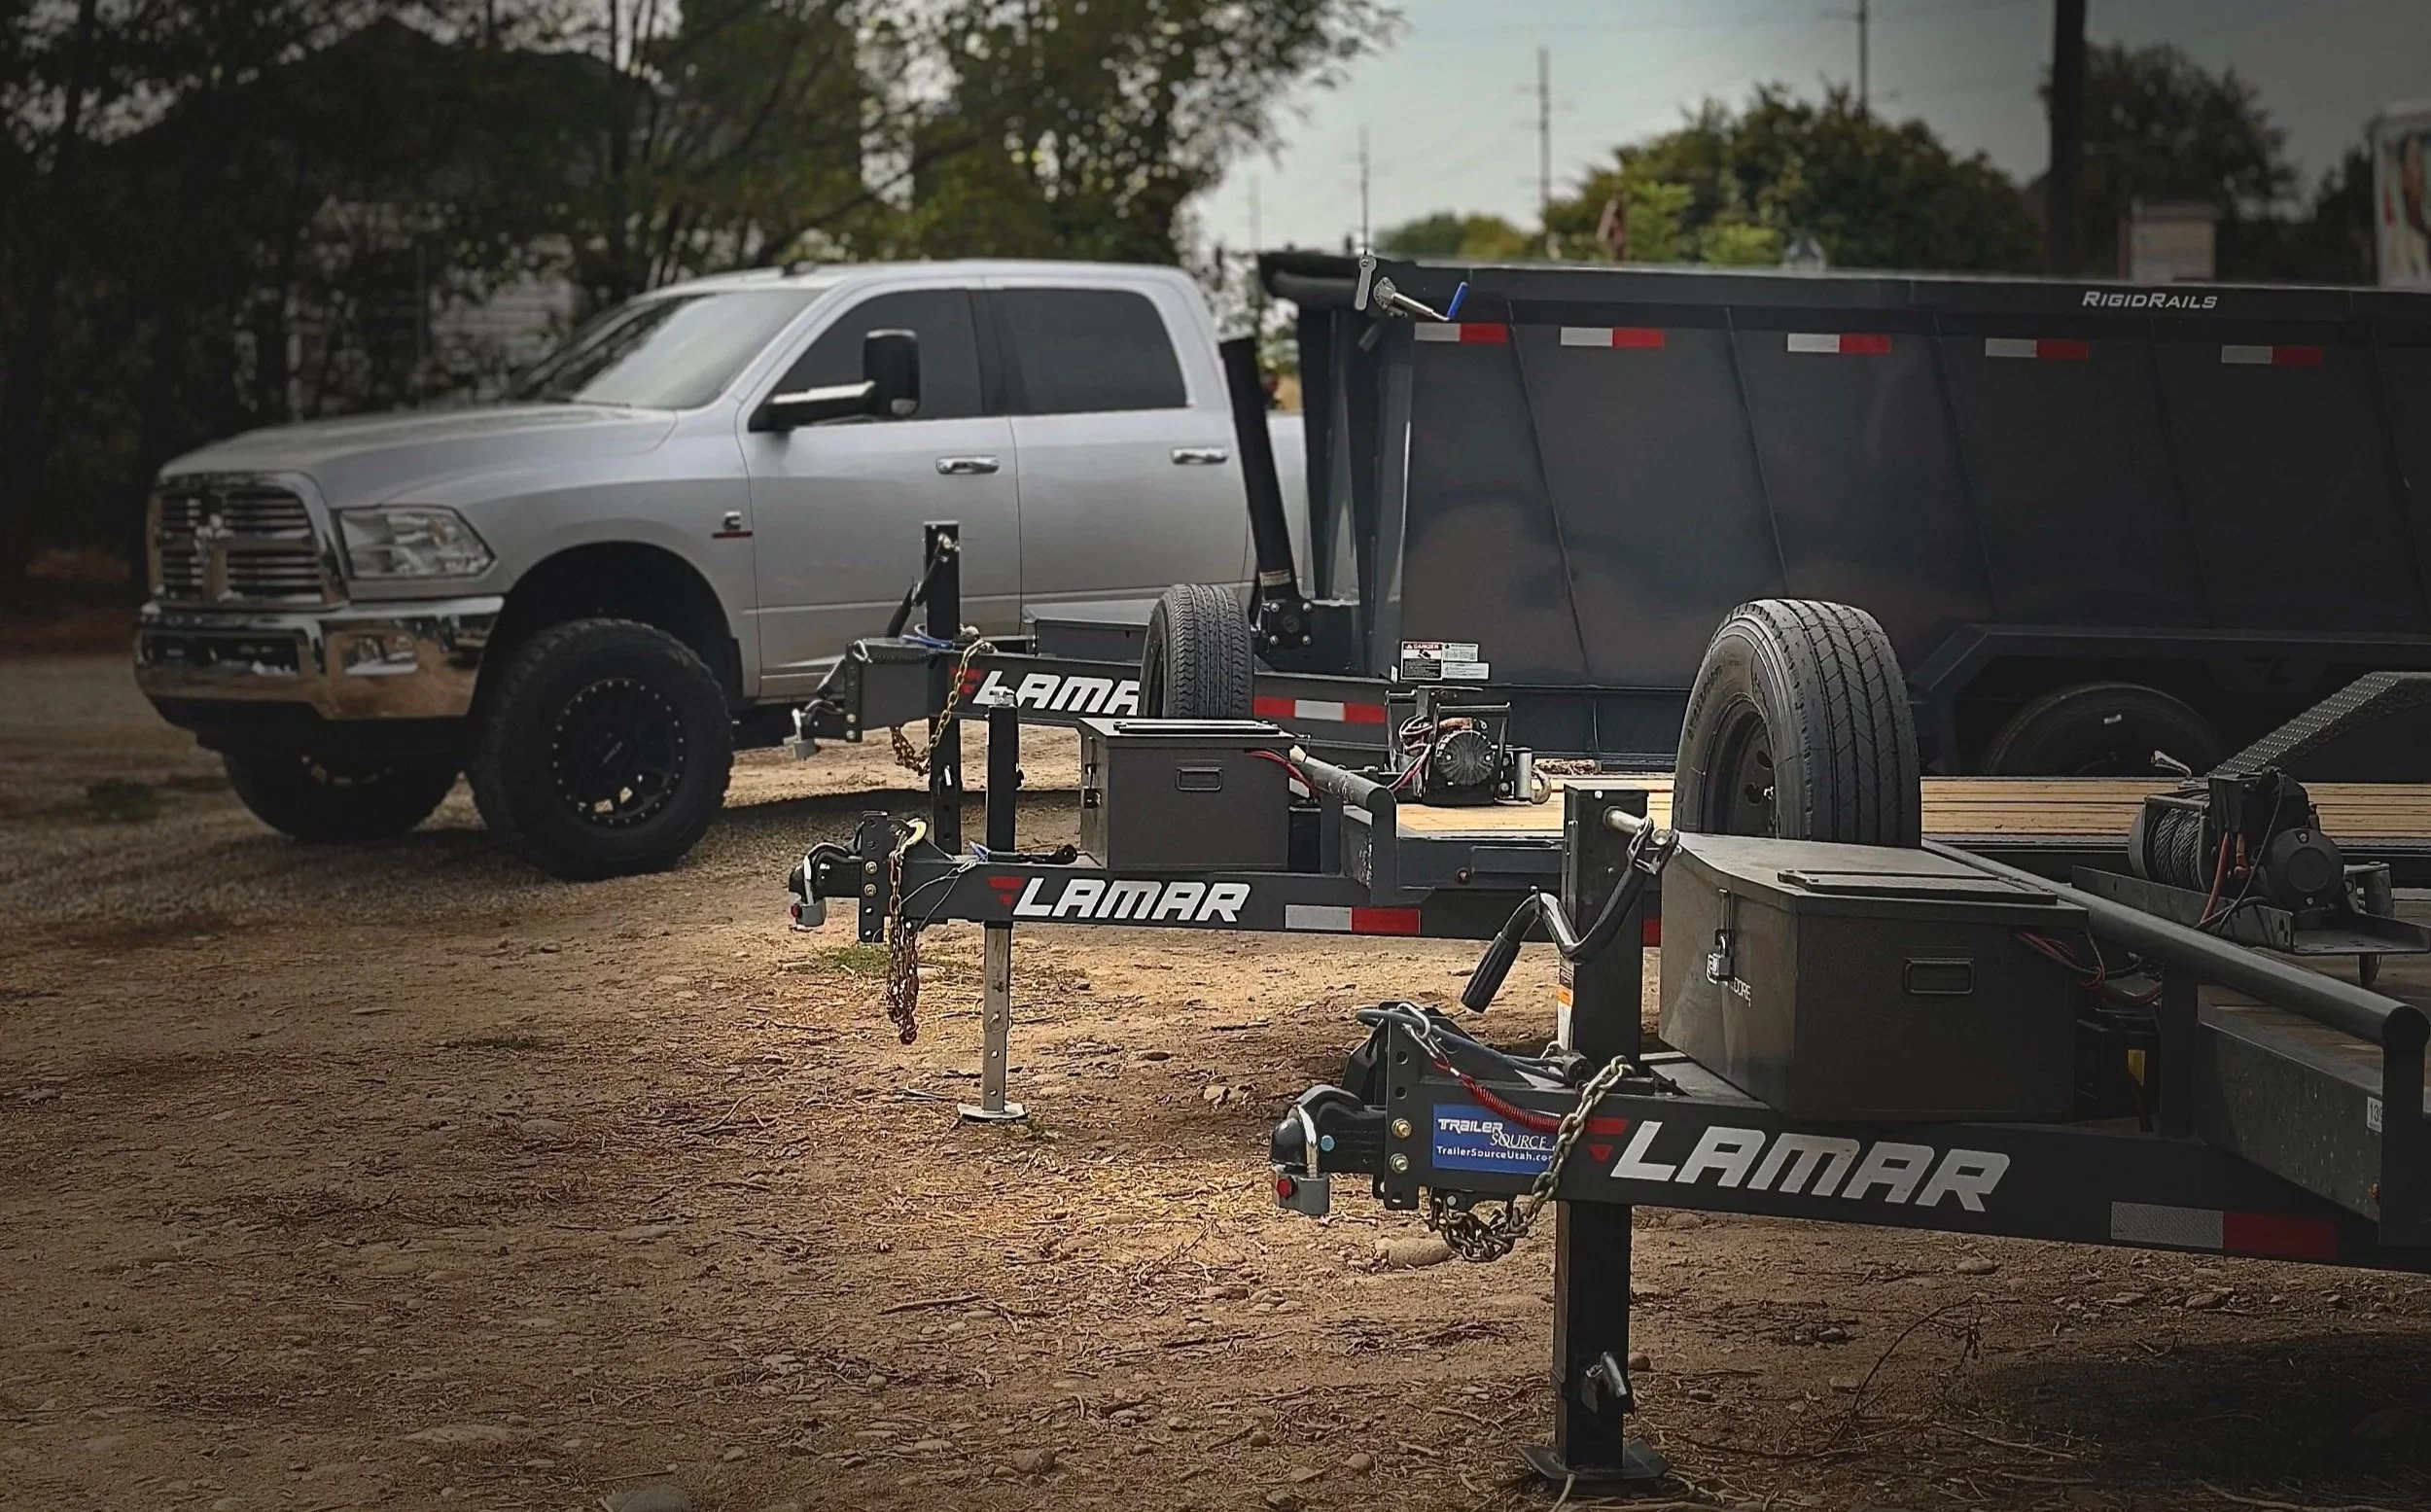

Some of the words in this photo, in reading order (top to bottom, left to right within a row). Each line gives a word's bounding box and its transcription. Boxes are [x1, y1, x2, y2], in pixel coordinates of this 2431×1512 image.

[2082, 291, 2218, 309] RIGIDRAILS
[1012, 877, 1251, 922] LAMAR
[1490, 1133, 1547, 1149] SOURCE
[1610, 1119, 2010, 1213] LAMAR
